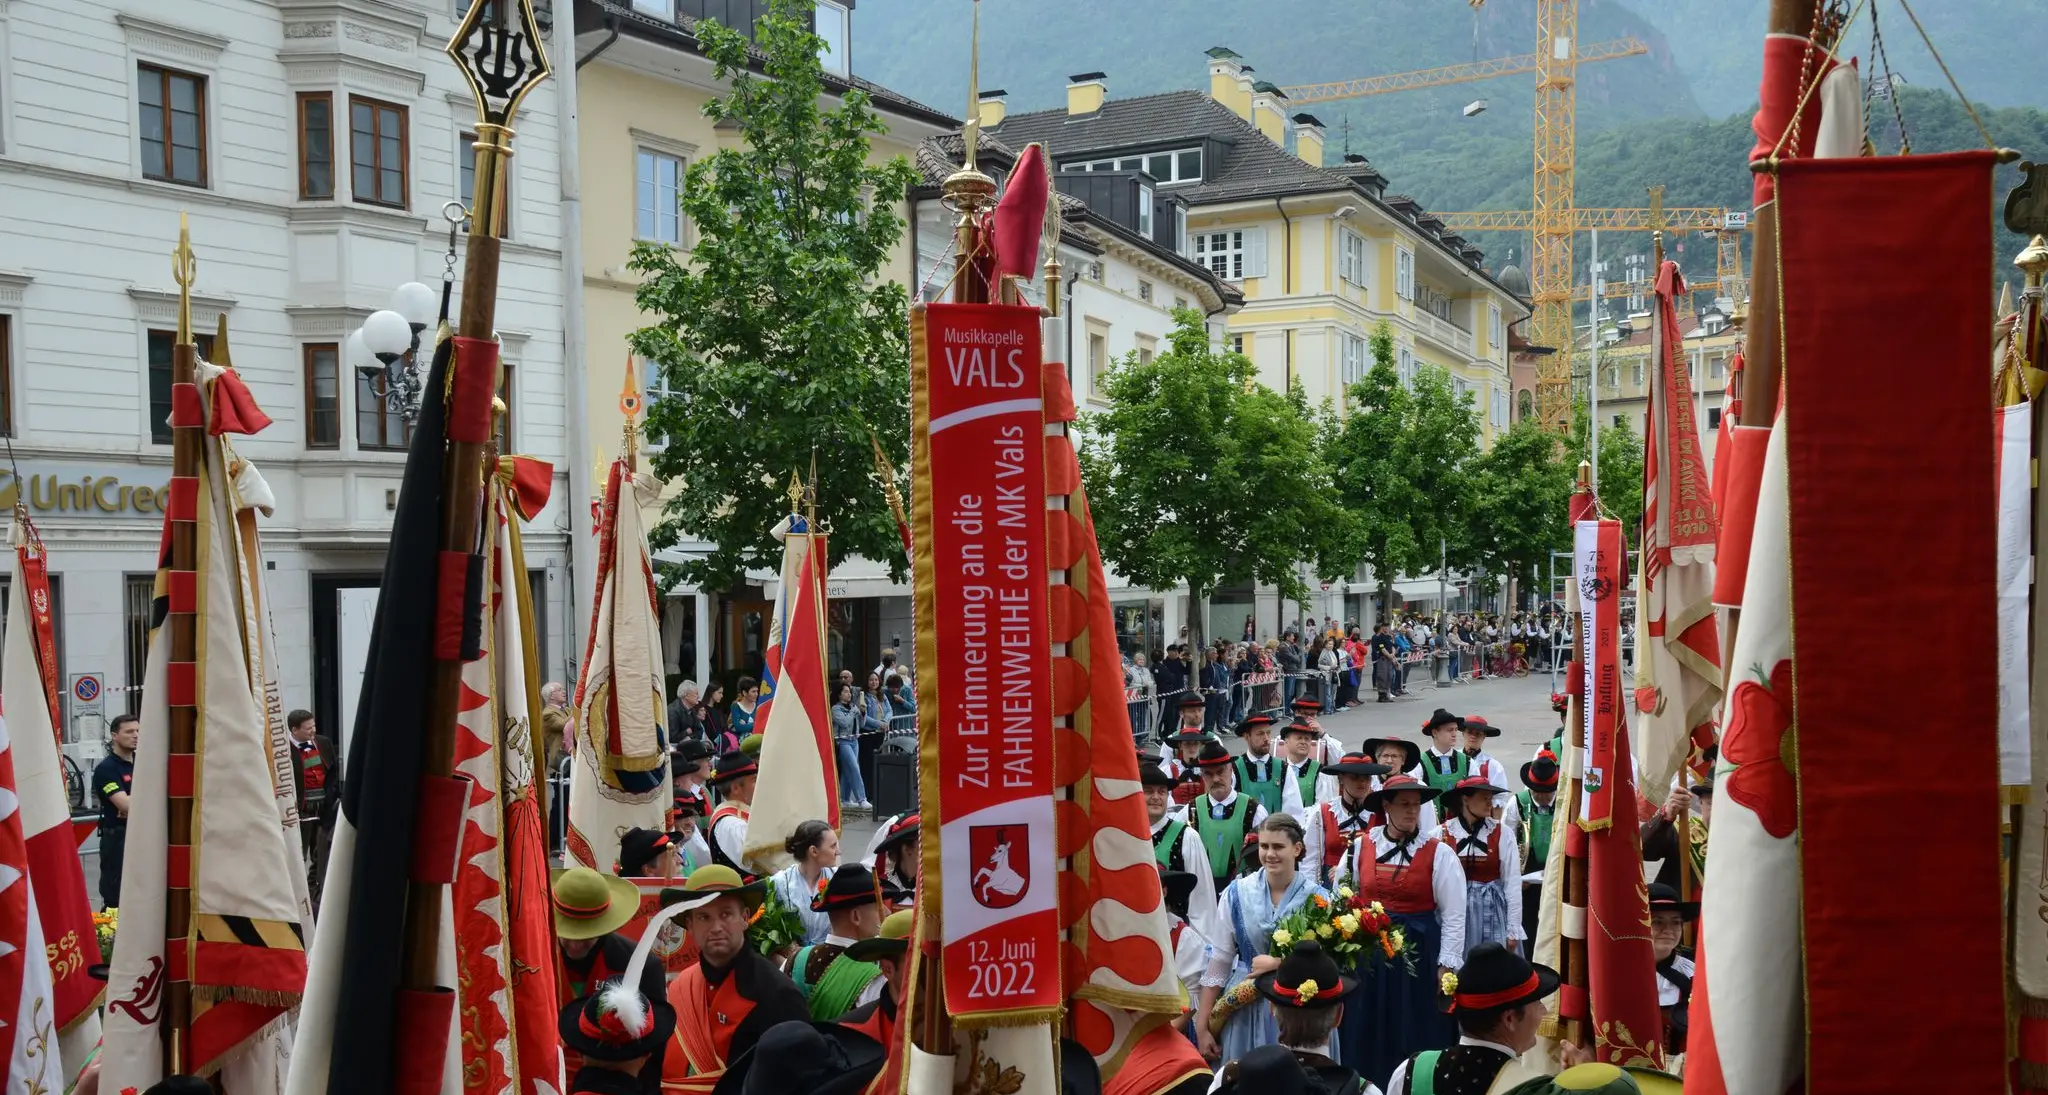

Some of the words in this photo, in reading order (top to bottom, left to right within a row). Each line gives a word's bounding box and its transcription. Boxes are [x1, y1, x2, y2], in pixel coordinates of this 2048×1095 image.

[944, 327, 1024, 348] Musikkapelle
[945, 348, 1025, 388] VALS
[993, 425, 1025, 479] Vals
[951, 494, 983, 535] die
[996, 484, 1026, 528] MK
[961, 544, 984, 577] an
[998, 535, 1028, 581] der
[1583, 564, 1608, 574] Jahre
[1588, 550, 1605, 562] 75
[958, 585, 993, 736] Erinnerung
[999, 588, 1033, 788] FAHNENWEIHE
[1597, 663, 1614, 716] Hafling
[958, 744, 989, 789] Zur
[967, 940, 995, 963] 12.
[999, 937, 1036, 961] Juni
[967, 961, 1036, 998] 2022
